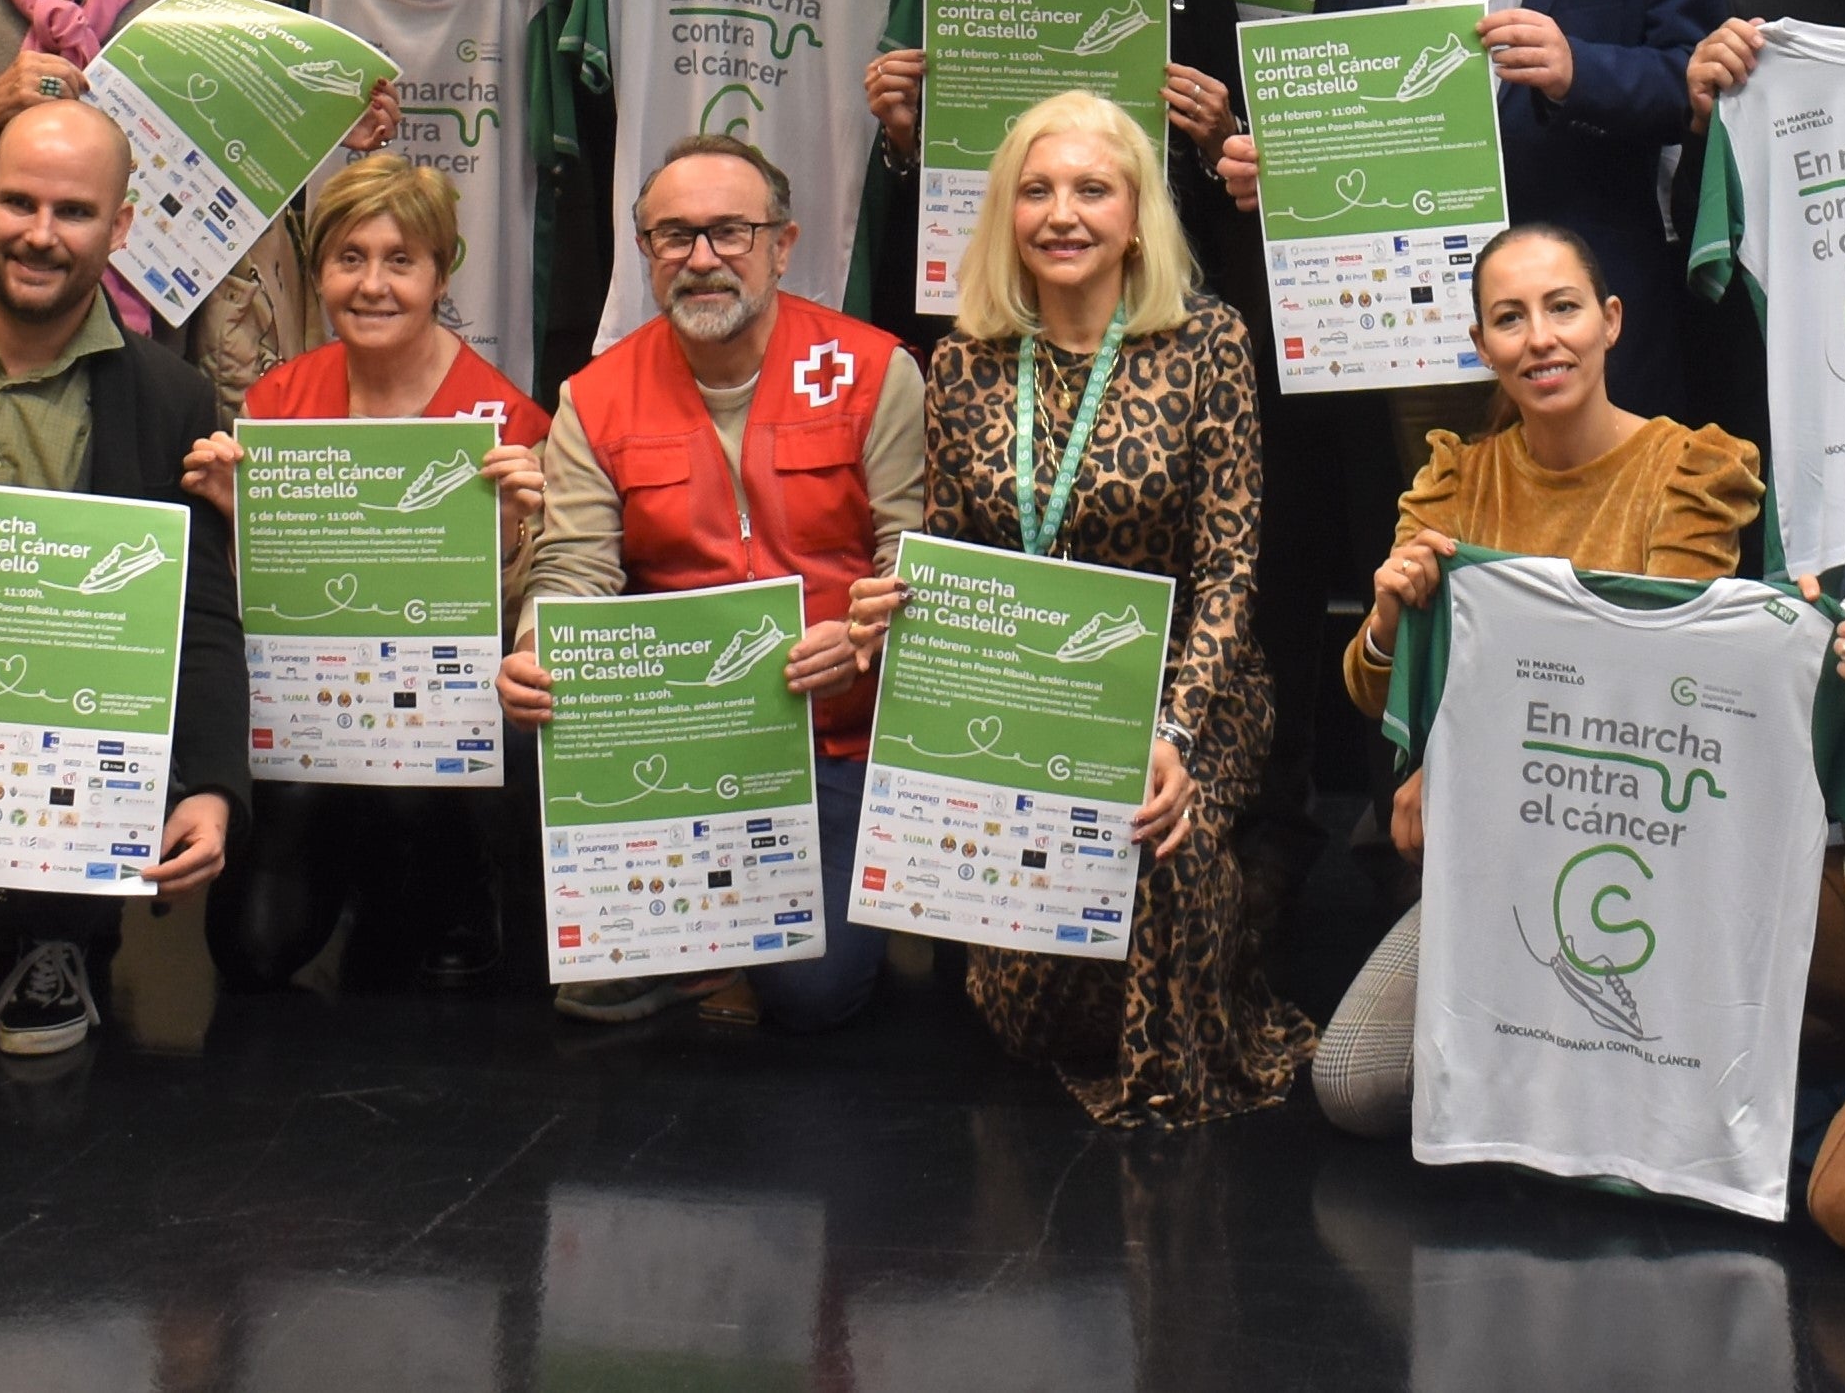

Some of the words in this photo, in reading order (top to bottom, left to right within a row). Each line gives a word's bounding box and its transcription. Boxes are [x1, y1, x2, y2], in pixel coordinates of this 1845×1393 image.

[672, 18, 755, 48] contra
[1253, 47, 1275, 63] VII
[1281, 41, 1349, 61] marcha
[674, 51, 698, 76] el
[702, 50, 788, 87] cáncer
[1255, 64, 1313, 83] contra
[1317, 59, 1340, 76] el
[1339, 54, 1400, 77] cáncer
[1257, 87, 1279, 100] en
[1283, 75, 1358, 97] Castelló
[1786, 108, 1826, 126] MARCHA
[1789, 113, 1834, 136] CASTELLÓ
[1793, 149, 1832, 181] En
[1812, 237, 1833, 260] el
[248, 447, 272, 462] VII
[279, 446, 351, 465] marcha
[249, 465, 311, 481] contra
[316, 464, 334, 480] el
[339, 461, 405, 482] cáncer
[249, 486, 273, 498] en
[278, 480, 357, 498] Castelló
[22, 538, 91, 558] cáncer
[910, 563, 935, 584] VII
[940, 573, 1015, 598] marcha
[911, 586, 977, 611] contra
[976, 597, 1002, 614] el
[1001, 596, 1070, 625] cáncer
[904, 605, 927, 620] en
[935, 607, 1017, 637] Castelló
[1516, 670, 1530, 678] EN
[1533, 671, 1585, 686] CASTELLÓ
[1517, 659, 1530, 668] VII
[1533, 661, 1576, 673] MARCHA
[1525, 701, 1571, 738] En
[1581, 707, 1722, 765] marcha
[1522, 760, 1639, 800] contra
[1519, 797, 1555, 826] el
[1562, 802, 1687, 848] cáncer
[1658, 1053, 1701, 1069] CÁNCER
